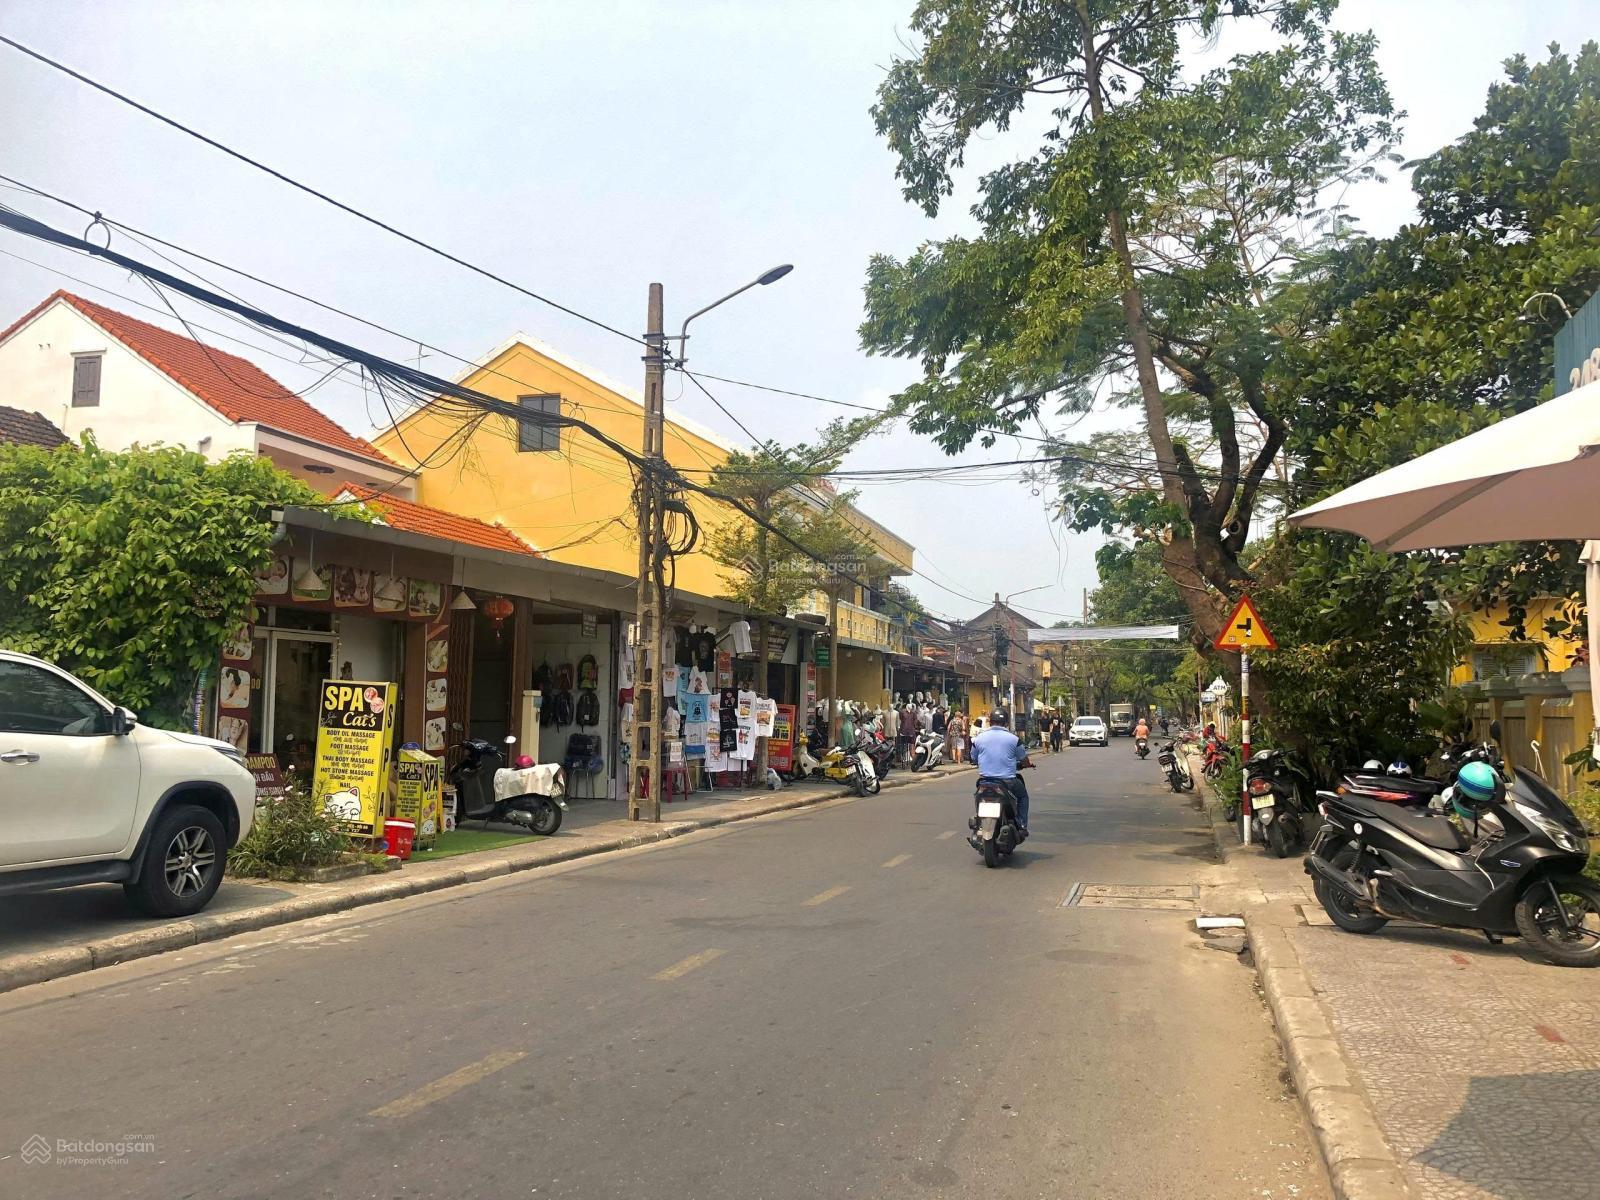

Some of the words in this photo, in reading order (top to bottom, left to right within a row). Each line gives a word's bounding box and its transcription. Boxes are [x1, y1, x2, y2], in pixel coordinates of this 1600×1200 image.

[324, 685, 364, 712] SPA
[343, 711, 377, 728] Cat's
[326, 729, 341, 737] BODY
[341, 730, 350, 738] OIL
[351, 731, 376, 739] MASSAGE
[345, 744, 369, 752] MASSAGE
[246, 756, 276, 769] HAMPOO
[335, 755, 349, 763] BODY
[350, 756, 375, 765] MASSAGE
[350, 768, 375, 777] MASSAGE
[399, 762, 415, 773] SPA
[424, 764, 439, 792] SPA
[269, 786, 285, 796] SINH
